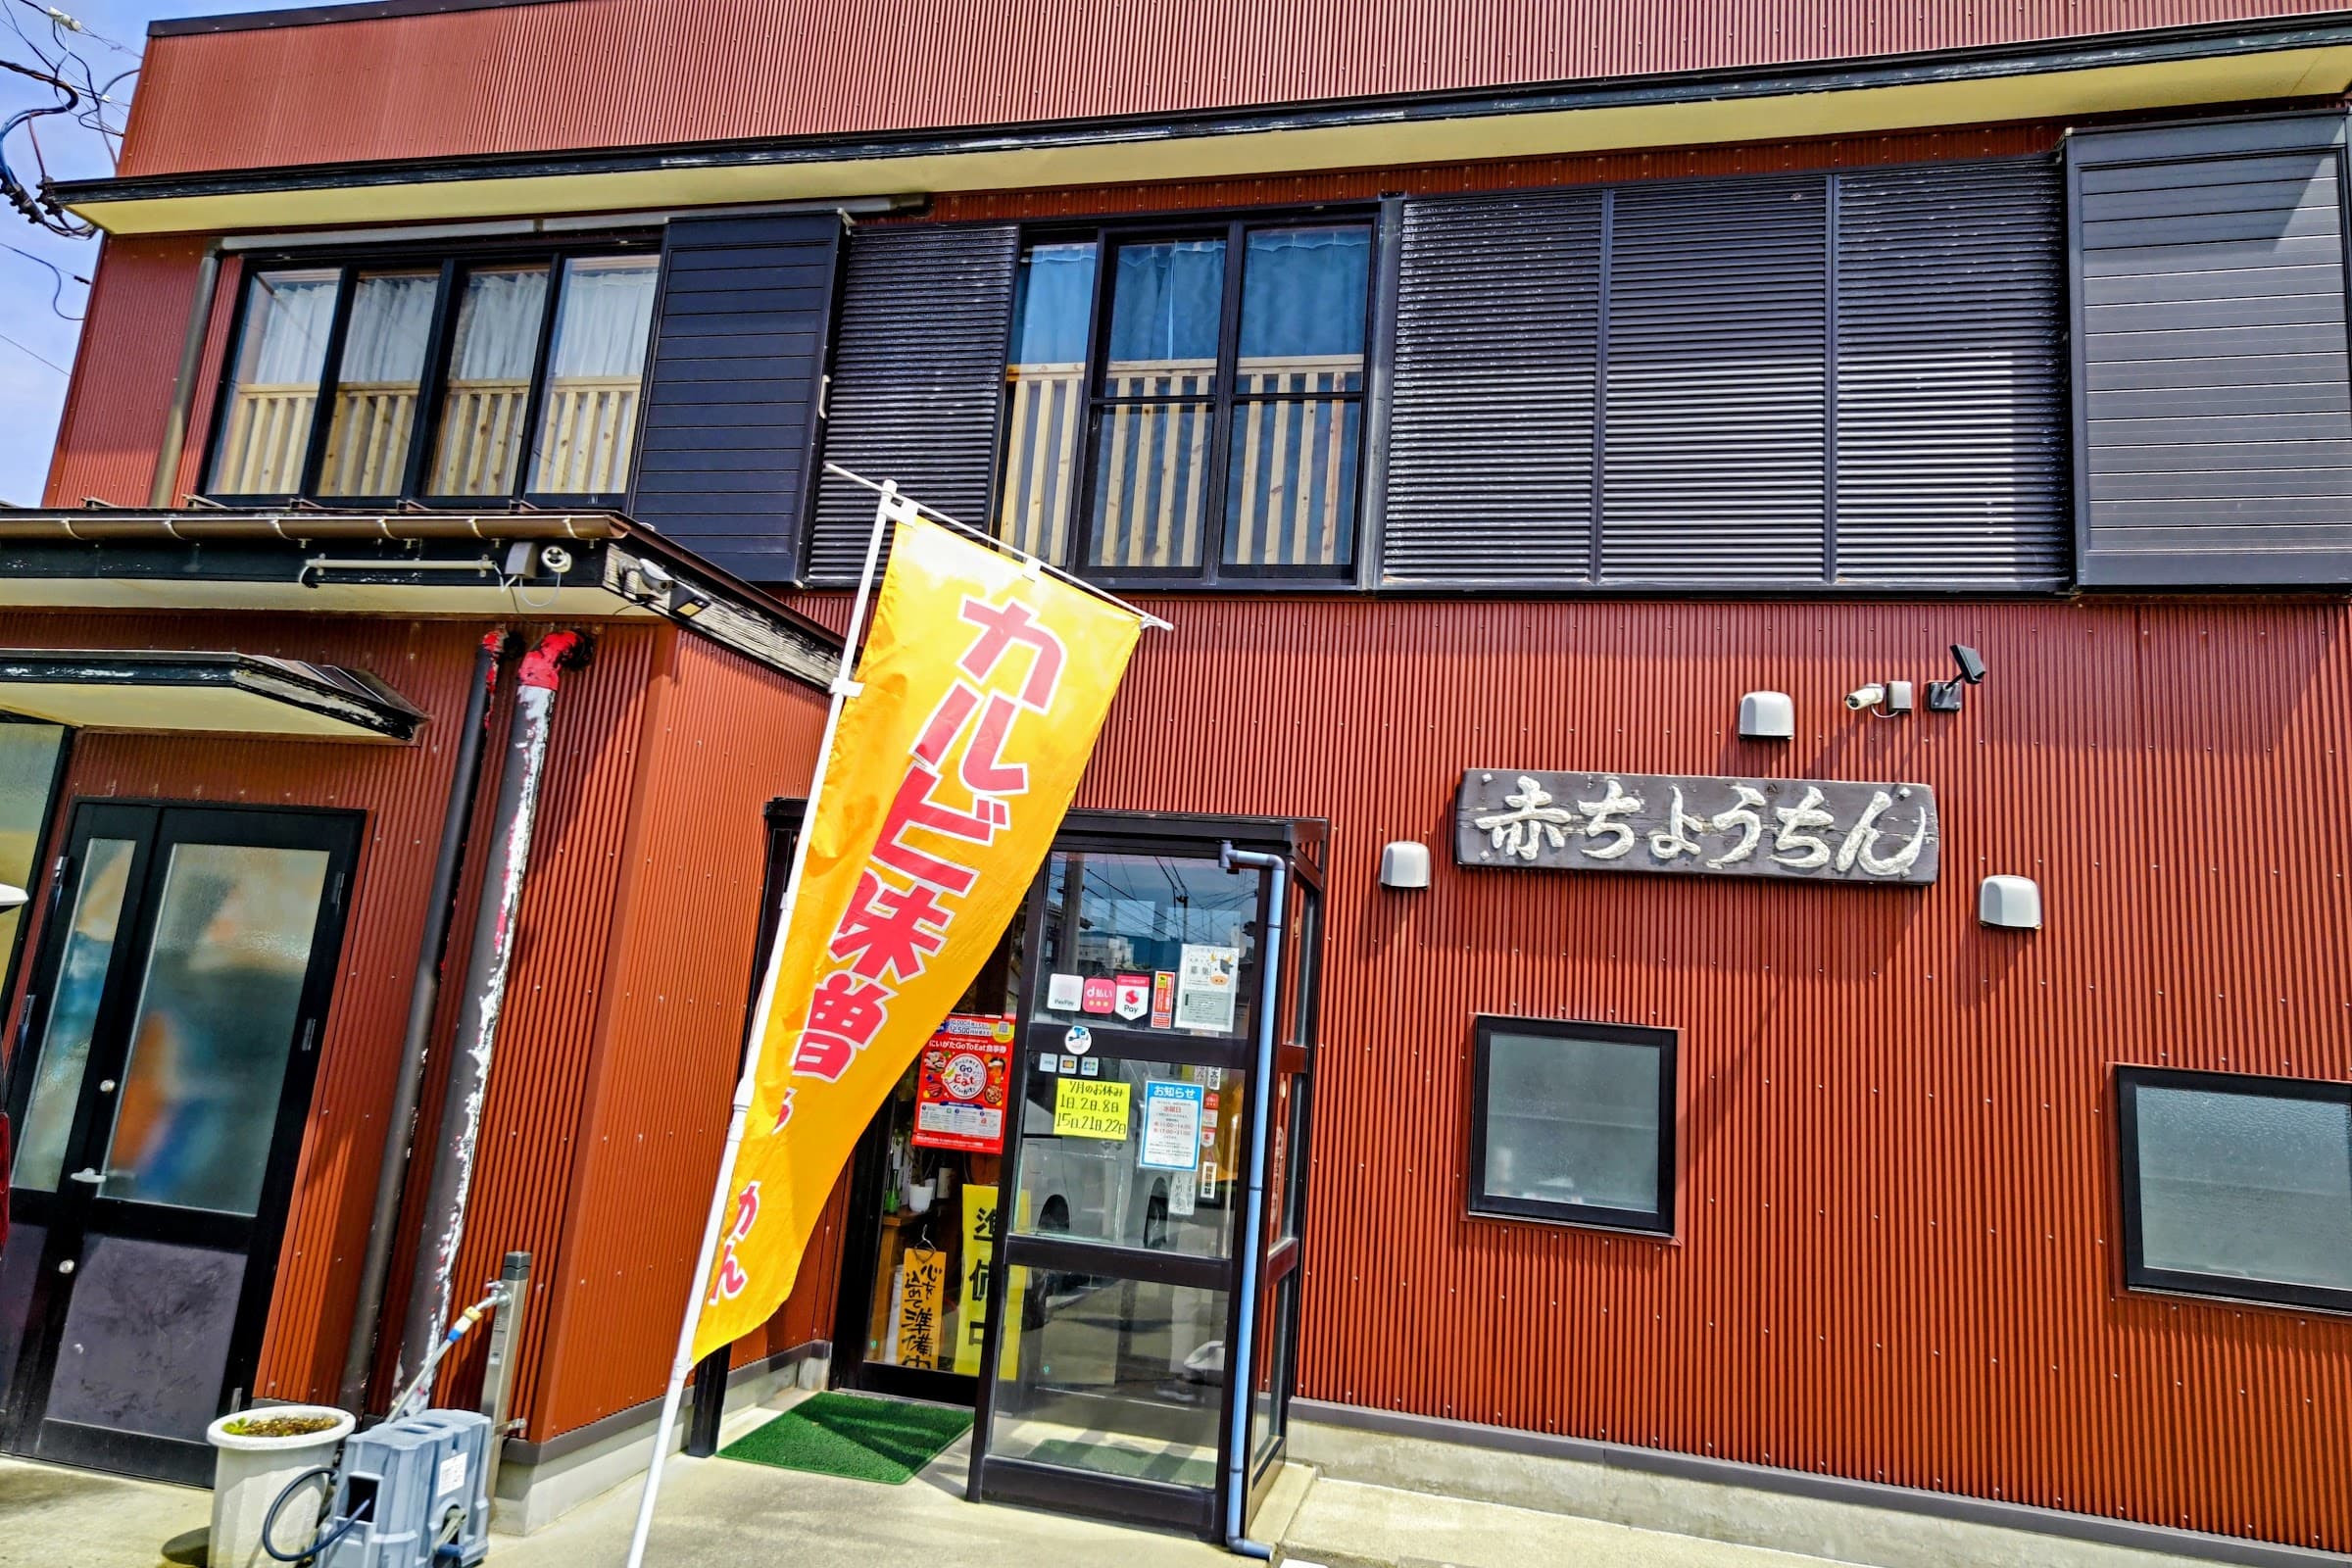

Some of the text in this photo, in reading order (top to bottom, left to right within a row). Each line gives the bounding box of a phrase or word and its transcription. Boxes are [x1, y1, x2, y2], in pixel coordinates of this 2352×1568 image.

[1475, 774, 1926, 876] 赤ちょうちん
[1124, 1004, 1139, 1014] Pay
[959, 1064, 973, 1073] Go
[954, 1073, 975, 1086] Eat
[1069, 1081, 1123, 1097] 7月のお休み
[1153, 1085, 1196, 1099] お知らせ
